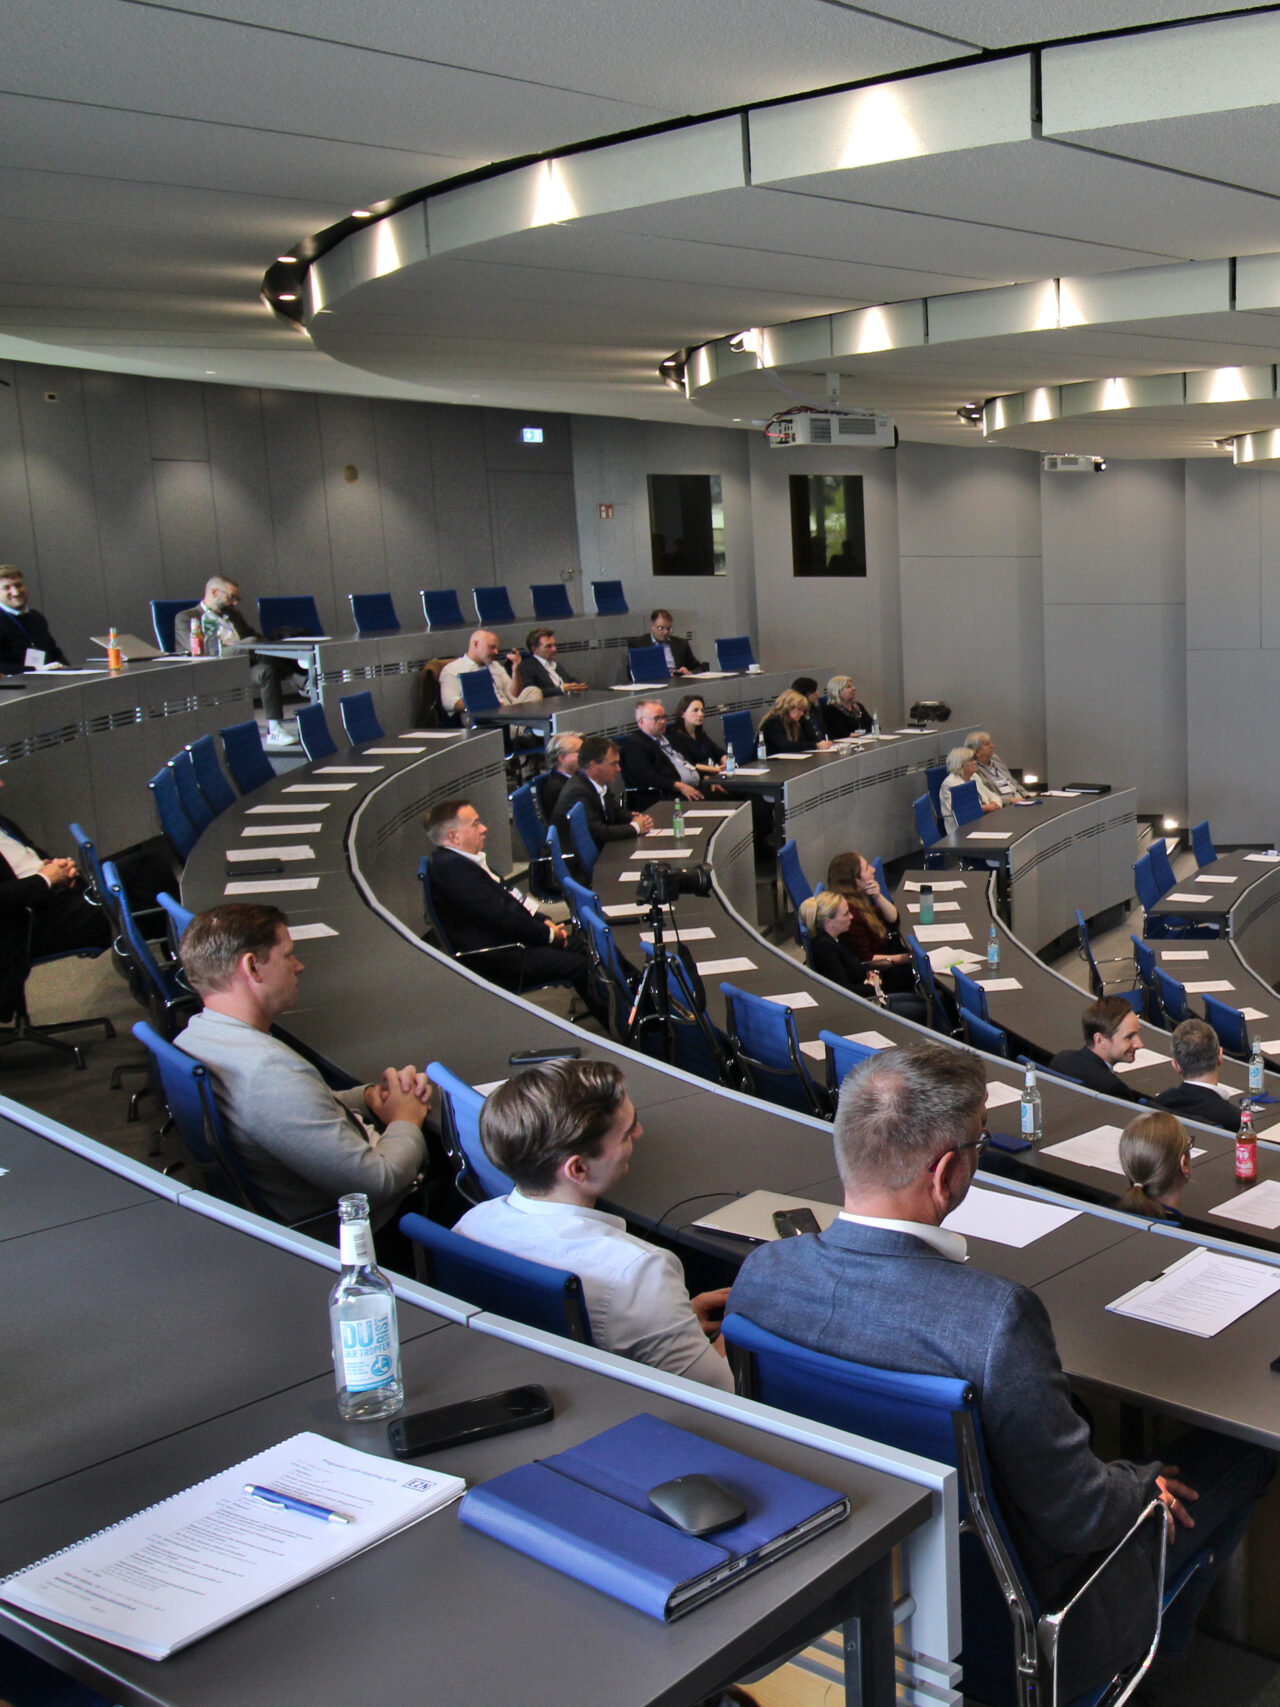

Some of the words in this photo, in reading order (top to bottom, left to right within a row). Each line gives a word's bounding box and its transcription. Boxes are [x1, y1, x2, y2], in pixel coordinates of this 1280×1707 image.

[342, 1321, 374, 1349] DU
[374, 1316, 390, 1344] BIST
[359, 1342, 391, 1357] TROPFEN
[408, 1479, 432, 1491] EZN
